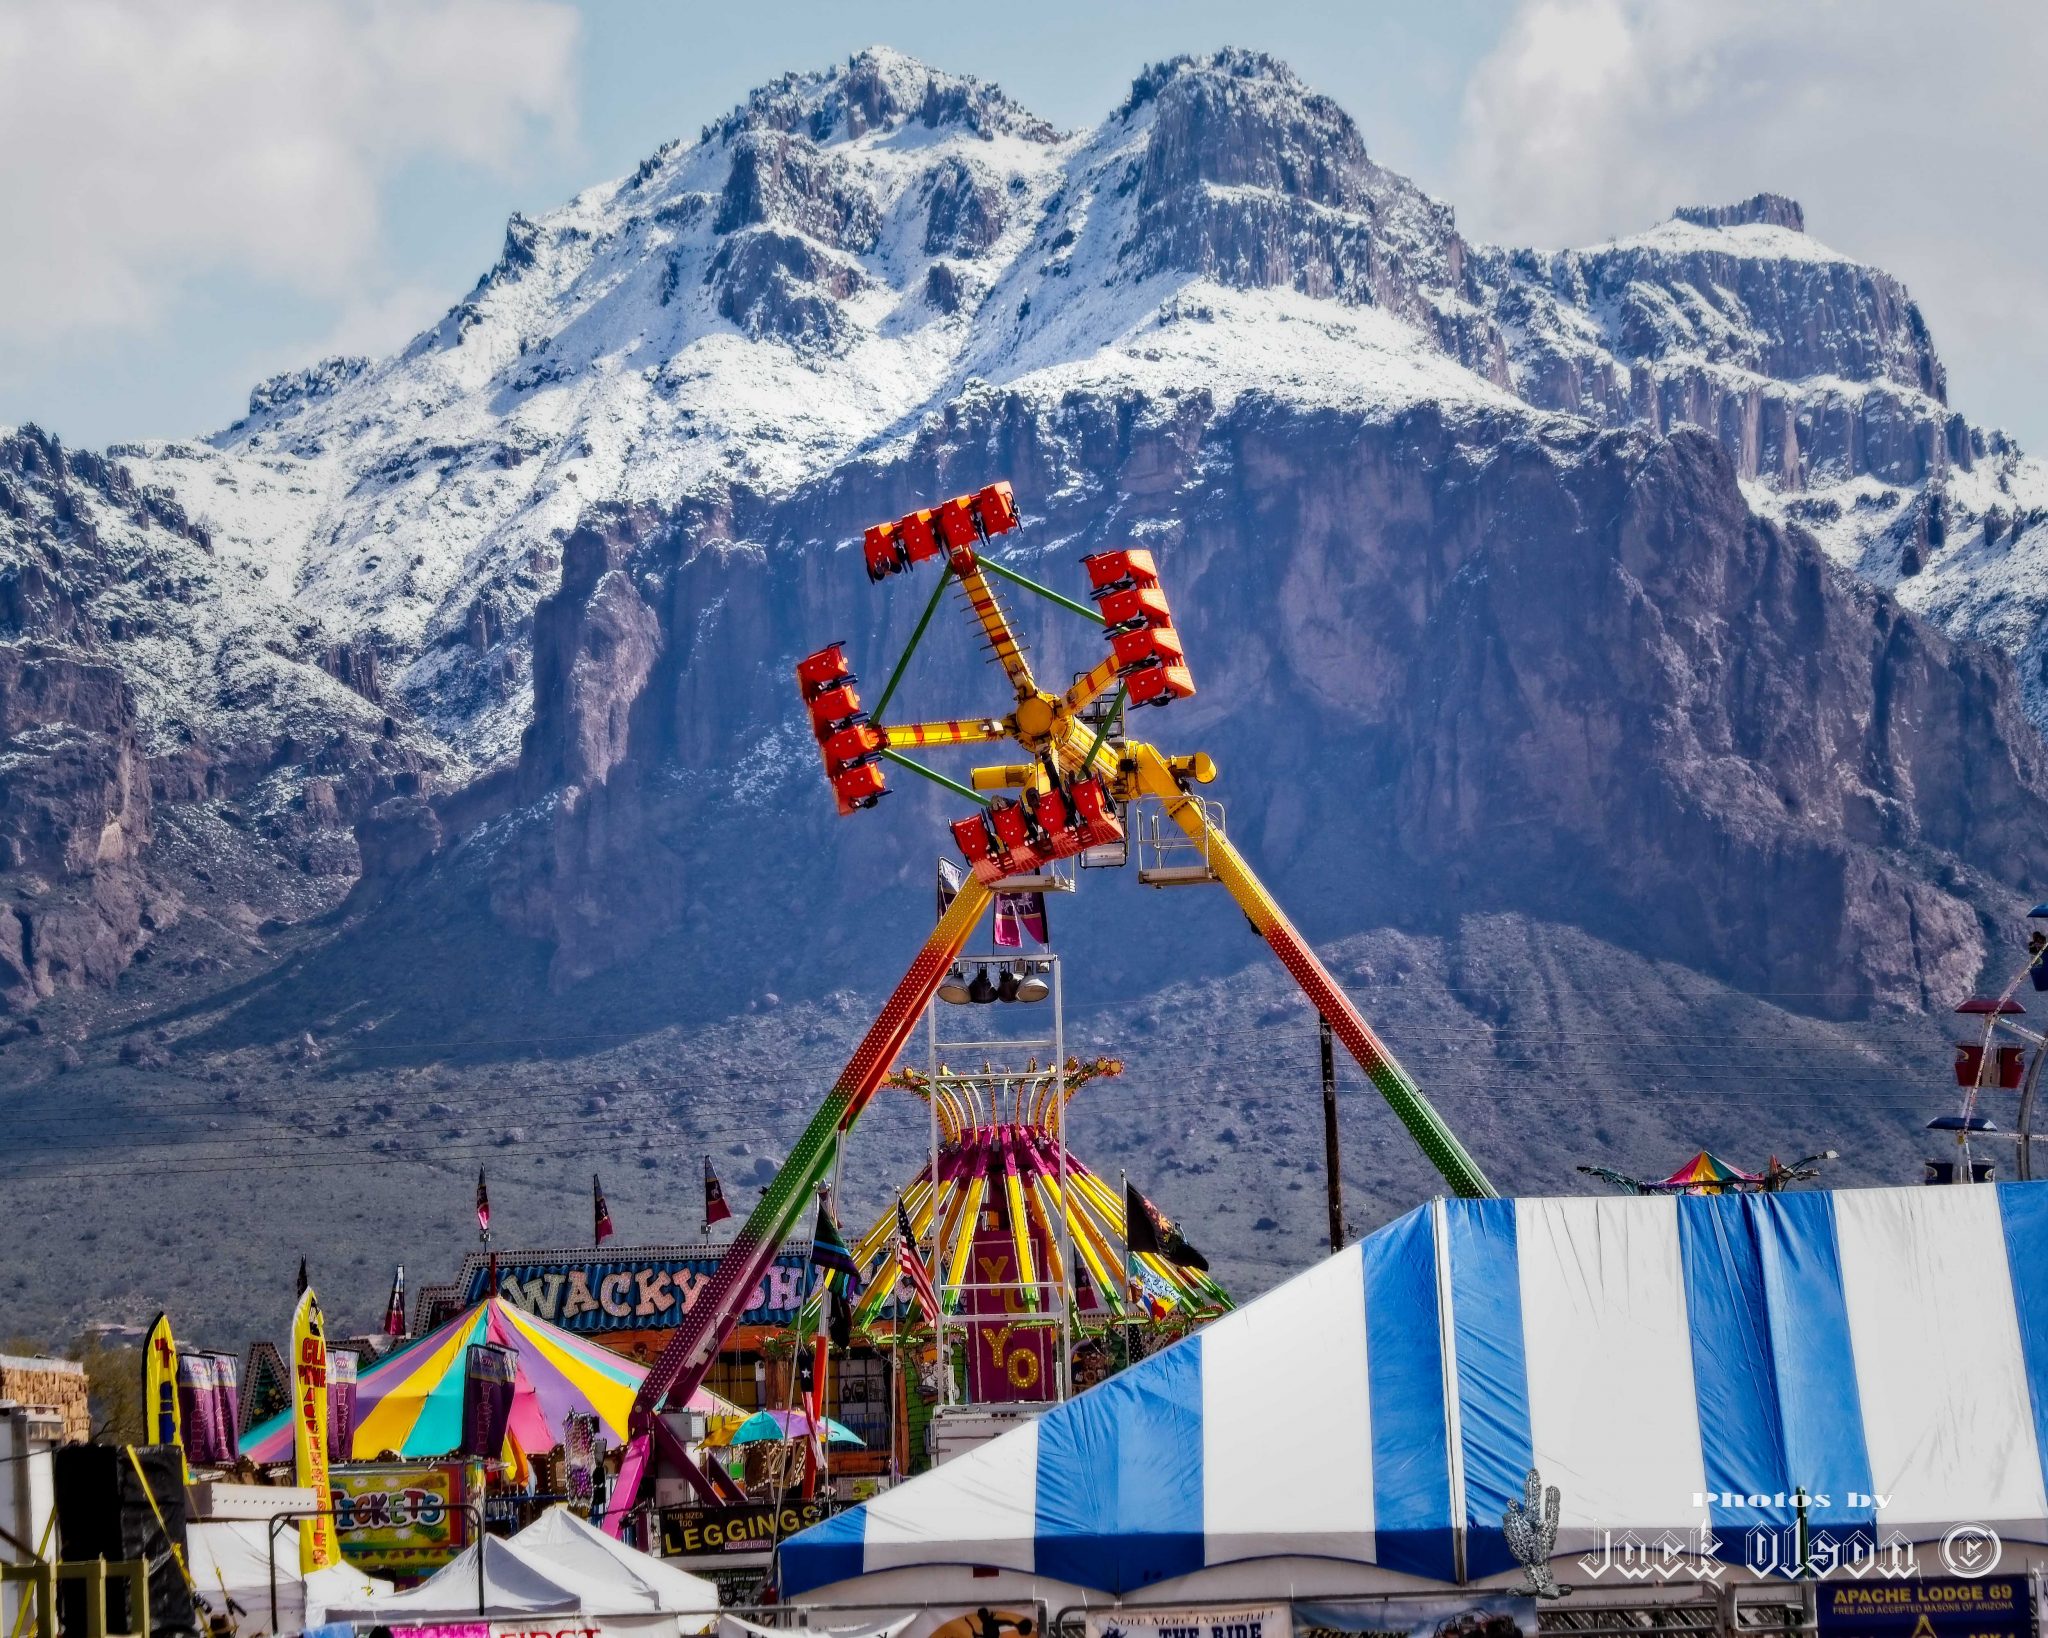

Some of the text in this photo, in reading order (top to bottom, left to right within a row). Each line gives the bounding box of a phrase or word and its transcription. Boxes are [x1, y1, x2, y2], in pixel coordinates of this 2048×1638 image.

[502, 1267, 710, 1320] WACKY
[685, 1511, 704, 1520] SIZES
[665, 1505, 820, 1554] LEGGINGS
[1834, 1584, 2013, 1604] APACHE LODGE 69
[1833, 1602, 2014, 1615] FREE AND ACCEPTED MASONS OF ARIZONA
[1108, 1615, 1147, 1627] Now
[1151, 1614, 1192, 1627] More
